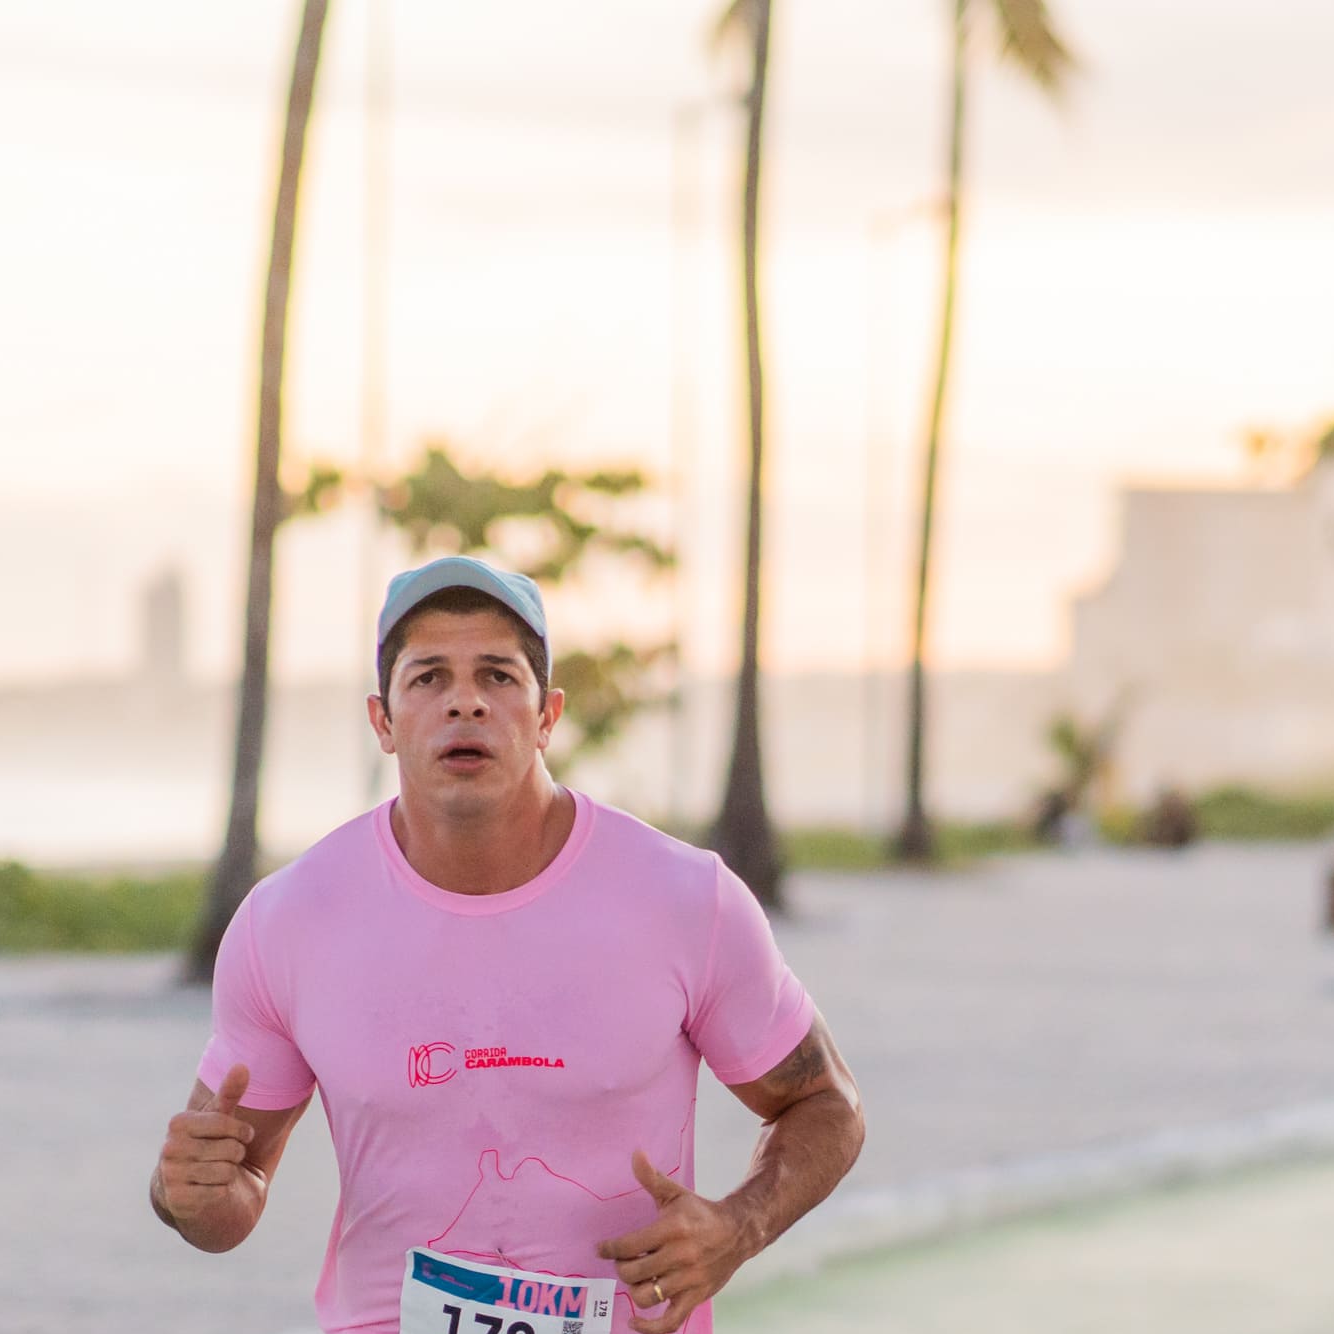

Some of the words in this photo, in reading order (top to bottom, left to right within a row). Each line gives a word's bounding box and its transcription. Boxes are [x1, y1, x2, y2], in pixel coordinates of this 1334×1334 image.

[465, 1048, 507, 1059] CORRIDA
[465, 1057, 565, 1069] CARAMBOLA
[495, 1276, 588, 1318] 10KM
[598, 1300, 608, 1318] 179
